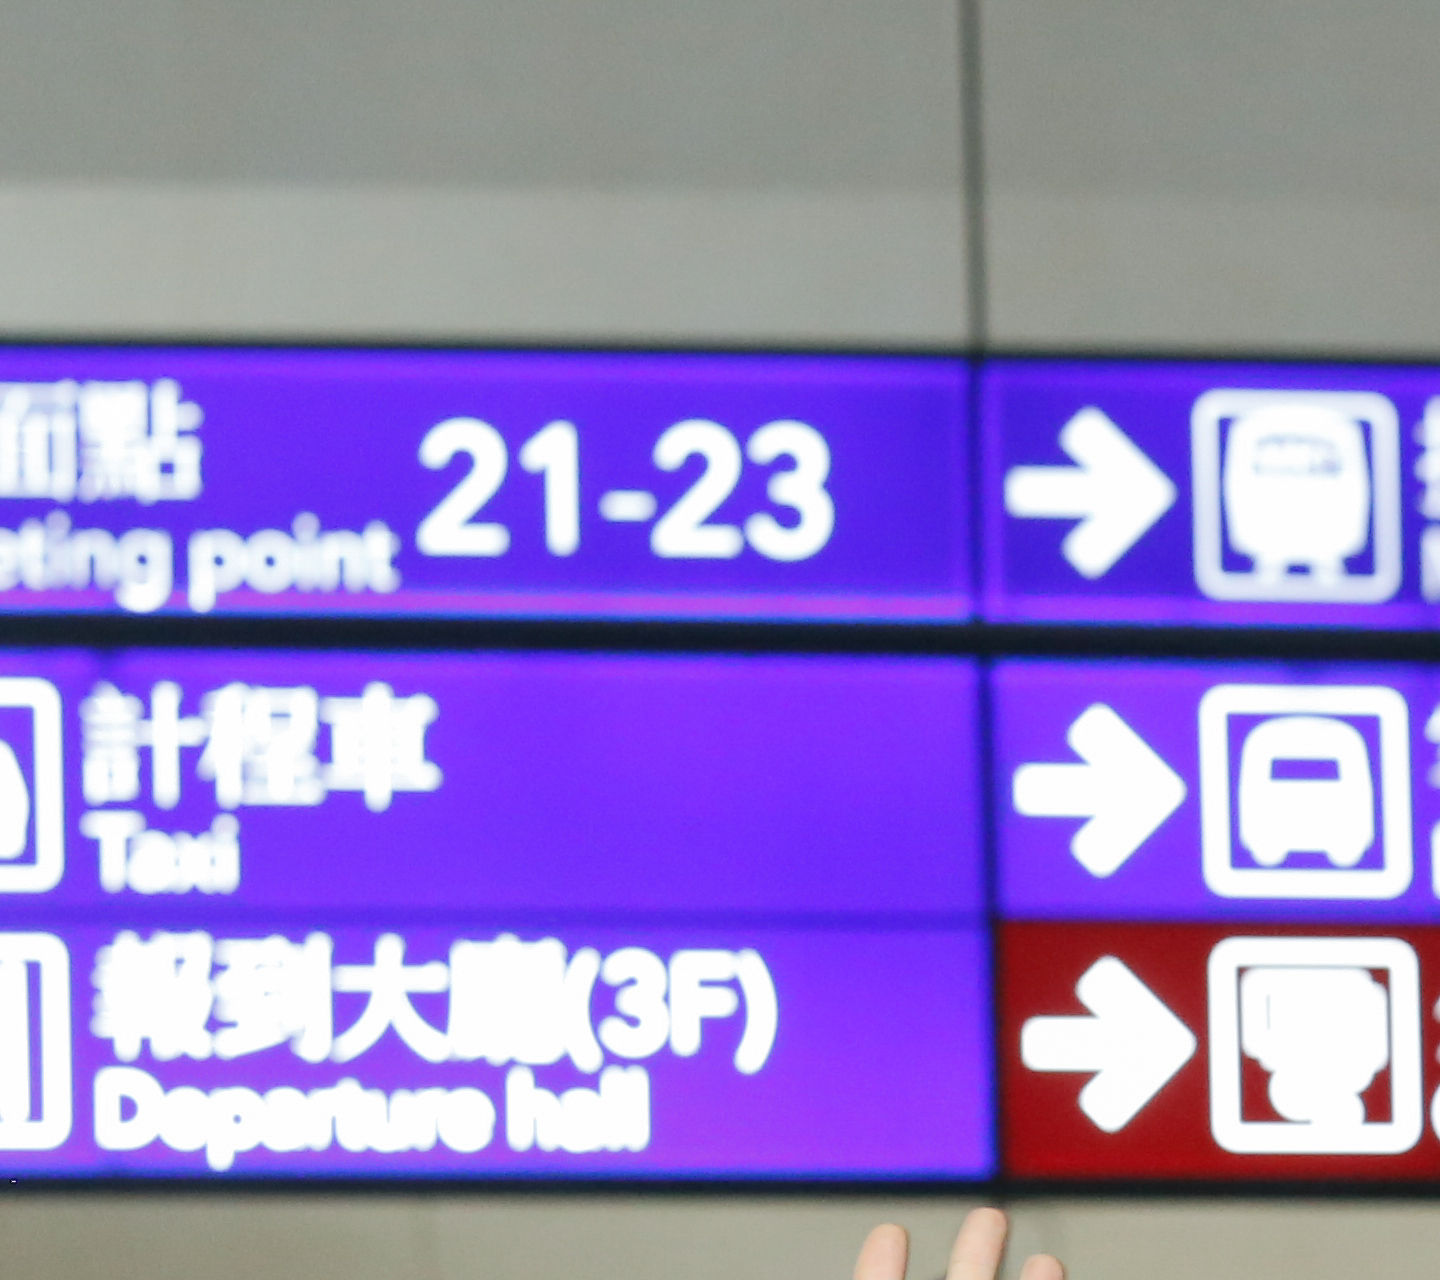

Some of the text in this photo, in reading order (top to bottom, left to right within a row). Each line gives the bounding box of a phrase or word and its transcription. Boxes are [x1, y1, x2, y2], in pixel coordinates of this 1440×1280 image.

[416, 417, 835, 561] 21-23
[188, 511, 399, 613] point
[79, 681, 443, 812] 計程車
[80, 809, 241, 895] Taxi
[93, 1064, 651, 1171] Departure hall
